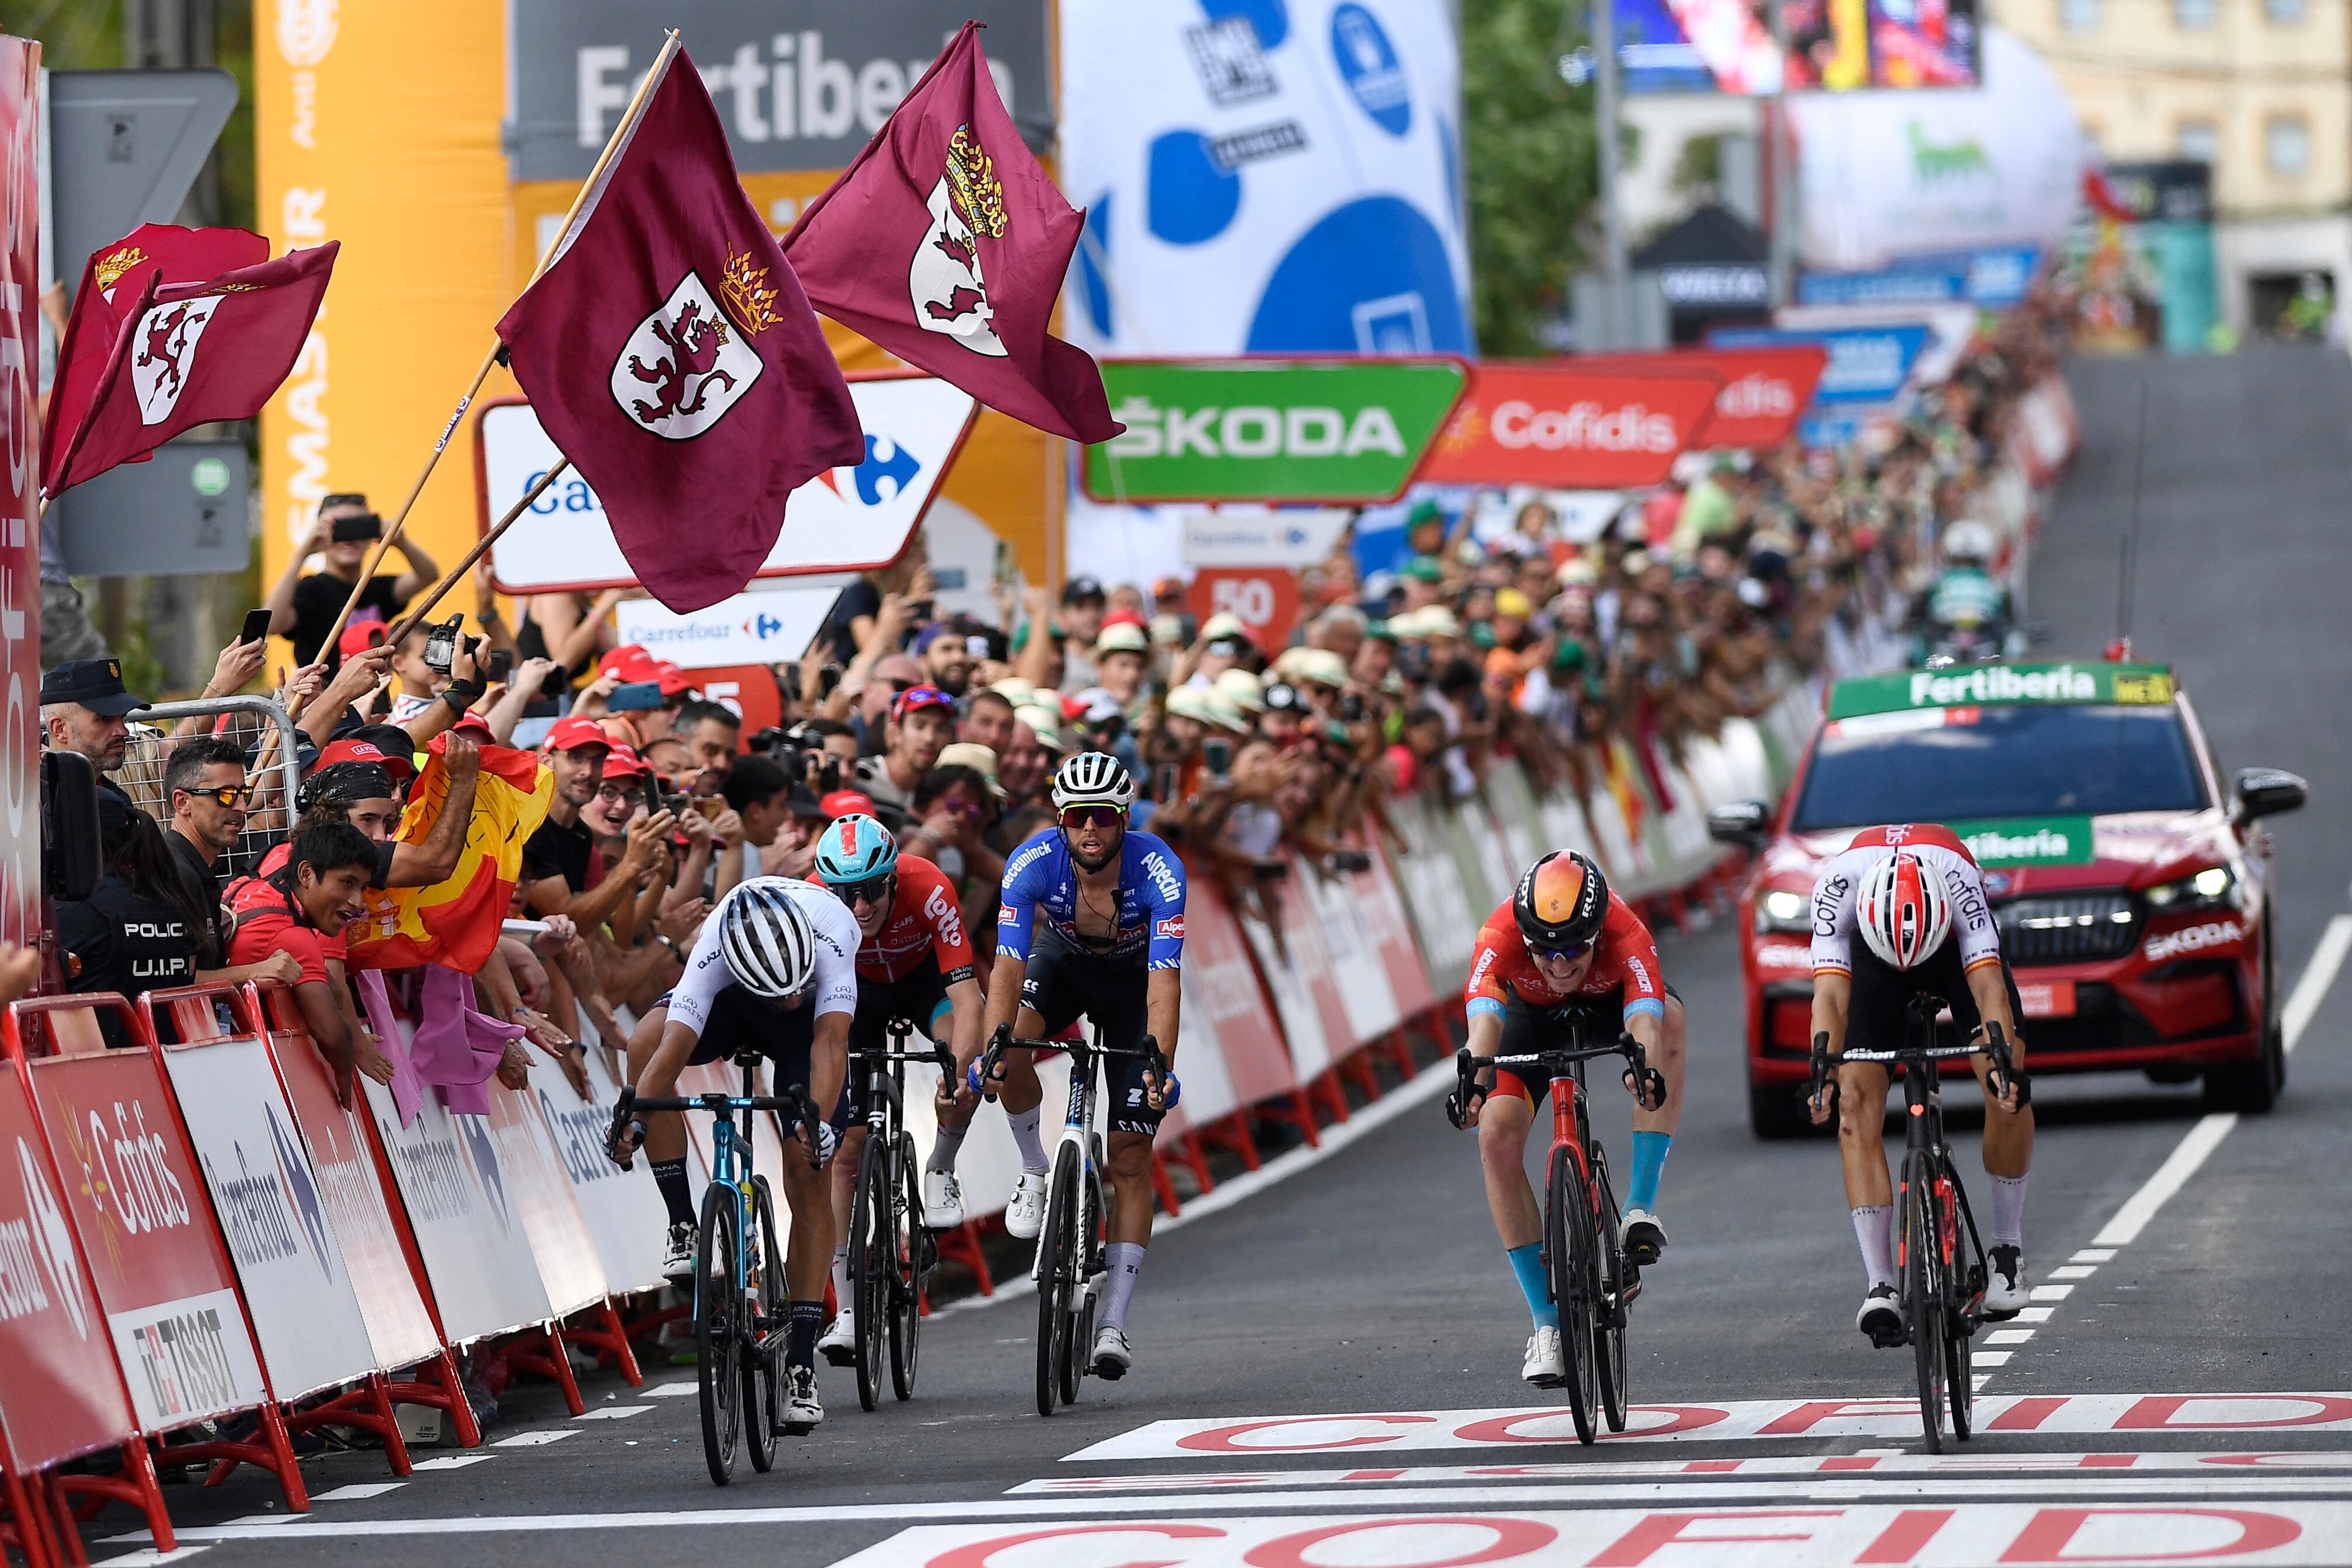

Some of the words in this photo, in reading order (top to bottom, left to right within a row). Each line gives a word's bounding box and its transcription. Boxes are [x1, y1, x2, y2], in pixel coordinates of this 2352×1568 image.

[1105, 396, 1406, 458] ŠKODA
[1490, 399, 1677, 453] Cofidis
[1210, 577, 1275, 626] 50
[629, 621, 731, 642] Carrefour
[1909, 664, 2097, 706] Fertiberia
[1001, 841, 1052, 889] deceuninck
[1140, 851, 1182, 903] Alpecin
[924, 884, 962, 947] lotto
[1582, 865, 1596, 918] RUDY
[1814, 874, 1849, 937] Cofidis
[124, 922, 187, 937] POLIC
[133, 958, 187, 977] U.I.P.
[952, 973, 972, 981] lotto
[1468, 947, 1498, 993] MERIDA
[1623, 955, 1654, 993] MERIDA
[89, 1099, 190, 1235] Cofidis
[156, 1308, 239, 1412] TISSOT
